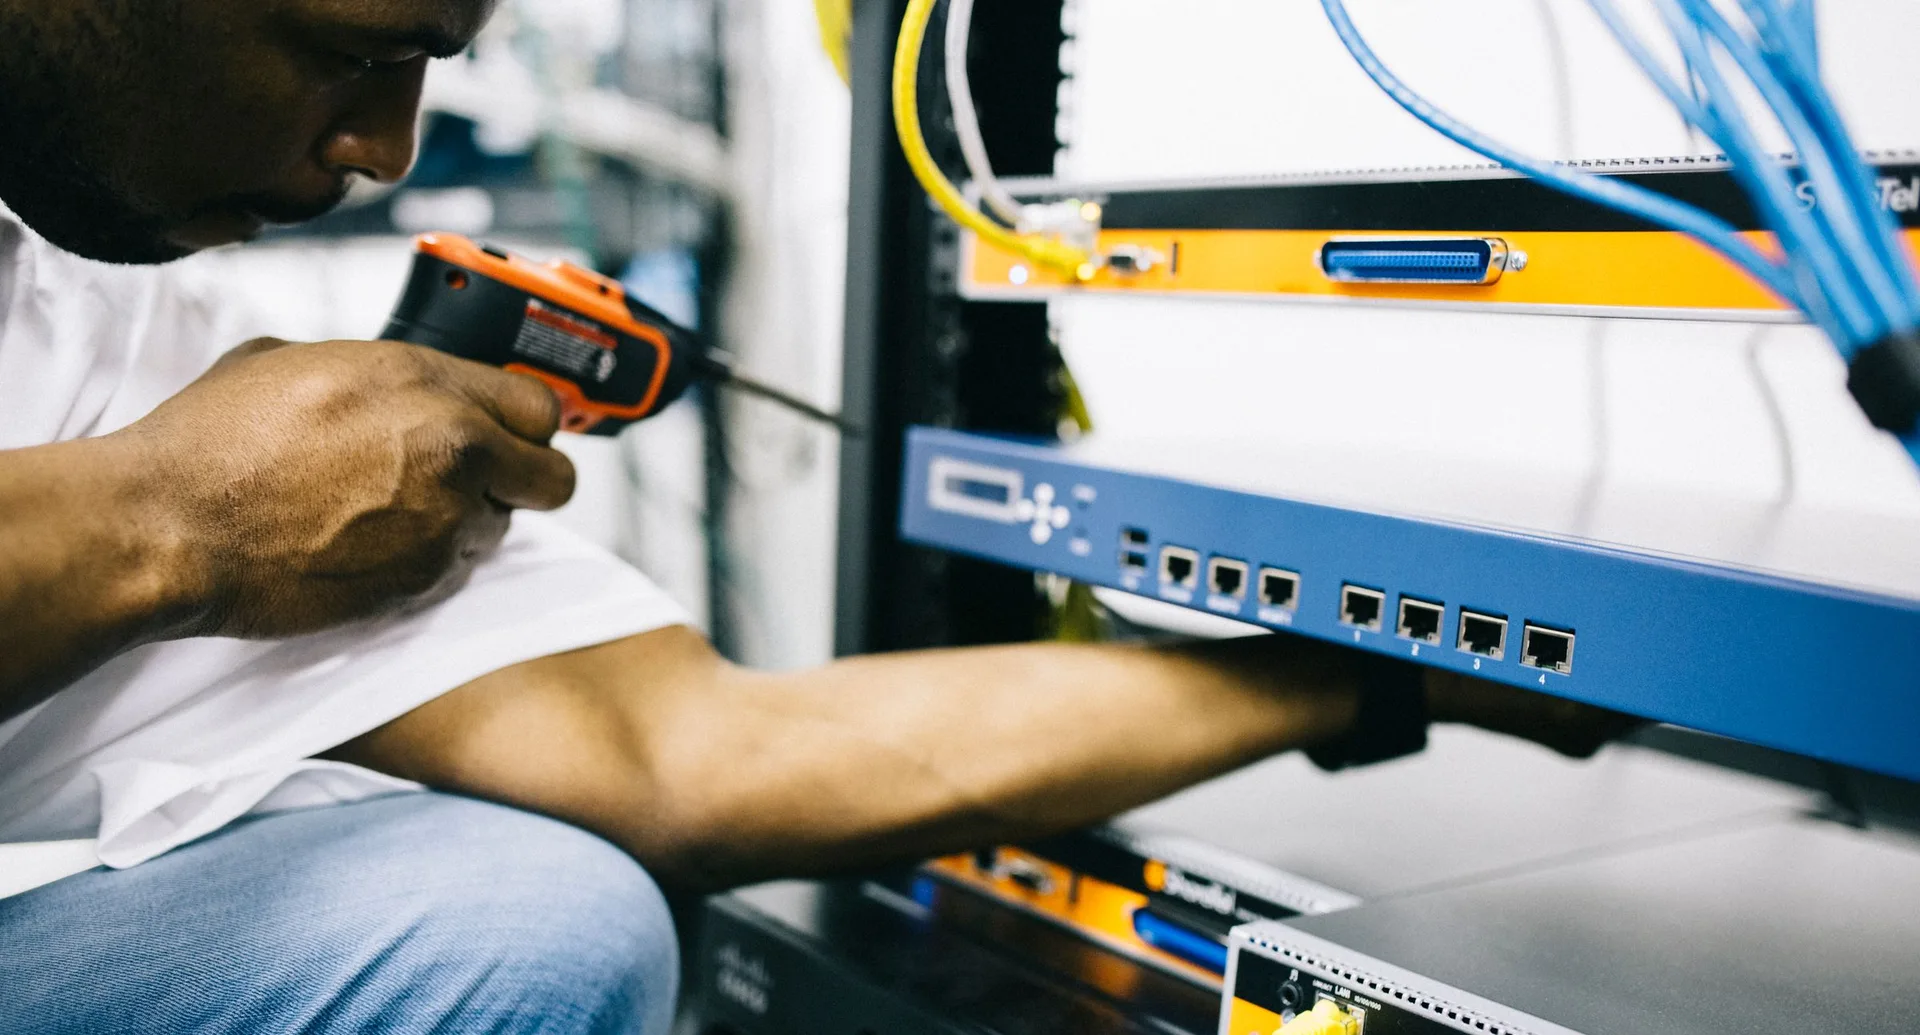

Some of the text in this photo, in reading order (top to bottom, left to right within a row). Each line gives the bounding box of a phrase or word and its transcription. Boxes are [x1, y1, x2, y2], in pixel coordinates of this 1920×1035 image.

[1795, 176, 1920, 212] STel
[1411, 642, 1420, 656] 2
[1473, 657, 1481, 671] 3
[1538, 673, 1546, 685] 4
